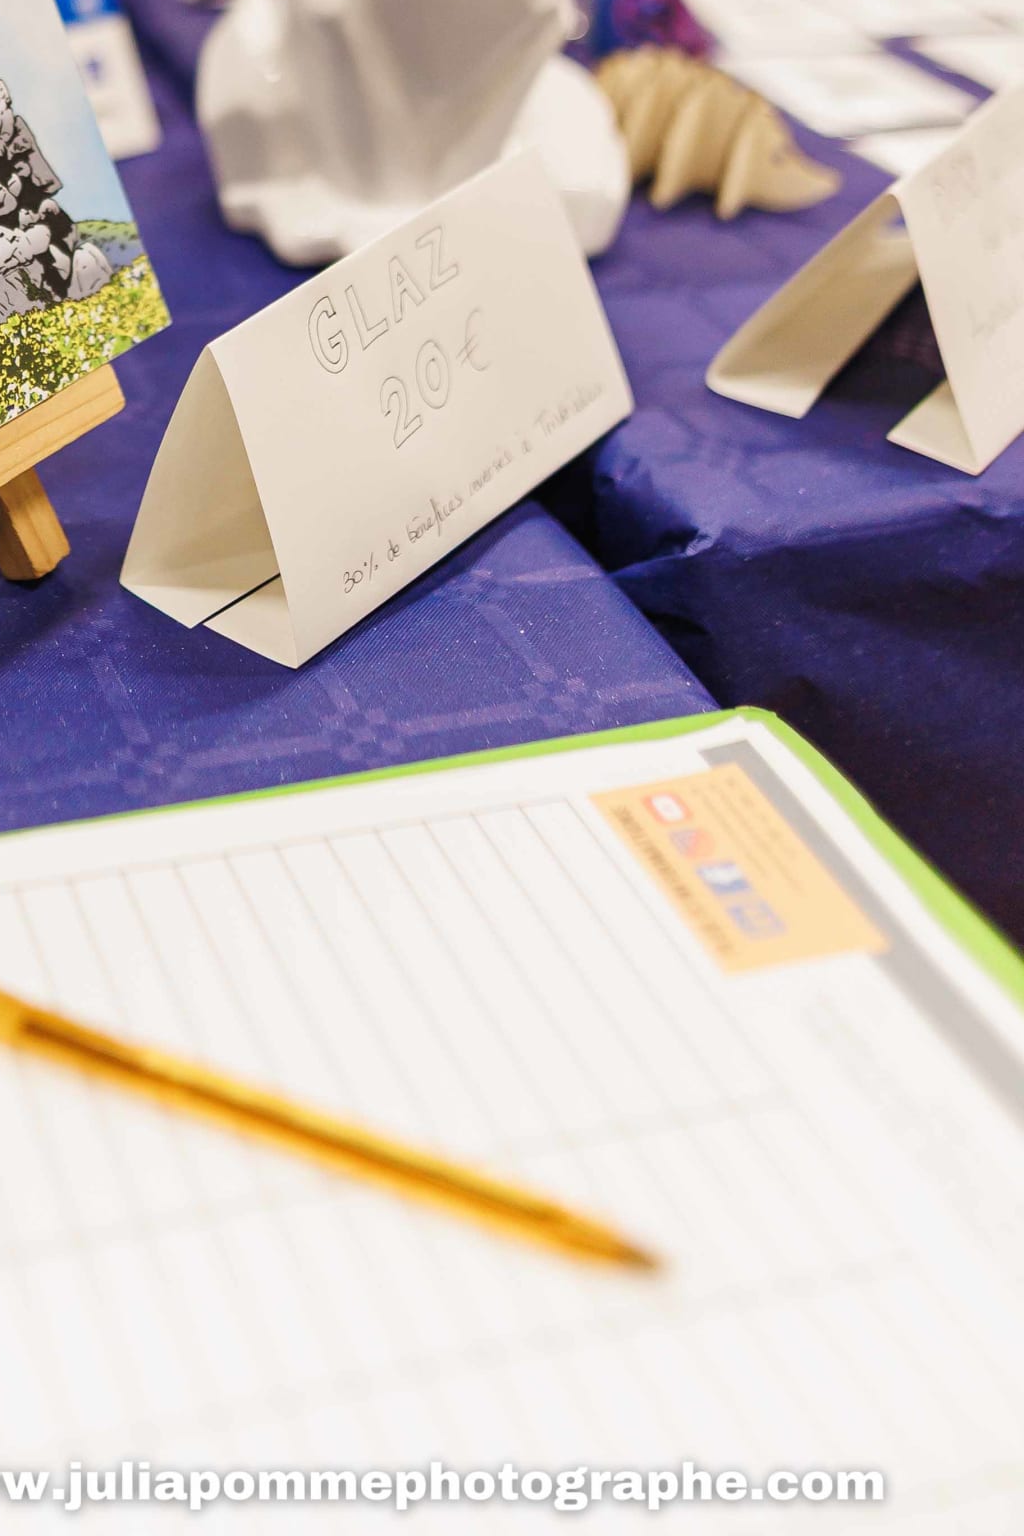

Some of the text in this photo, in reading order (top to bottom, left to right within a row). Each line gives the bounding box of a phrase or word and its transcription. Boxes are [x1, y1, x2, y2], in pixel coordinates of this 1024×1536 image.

[307, 225, 460, 374] GLAZ
[342, 551, 379, 594] 30%
[387, 538, 401, 562] de
